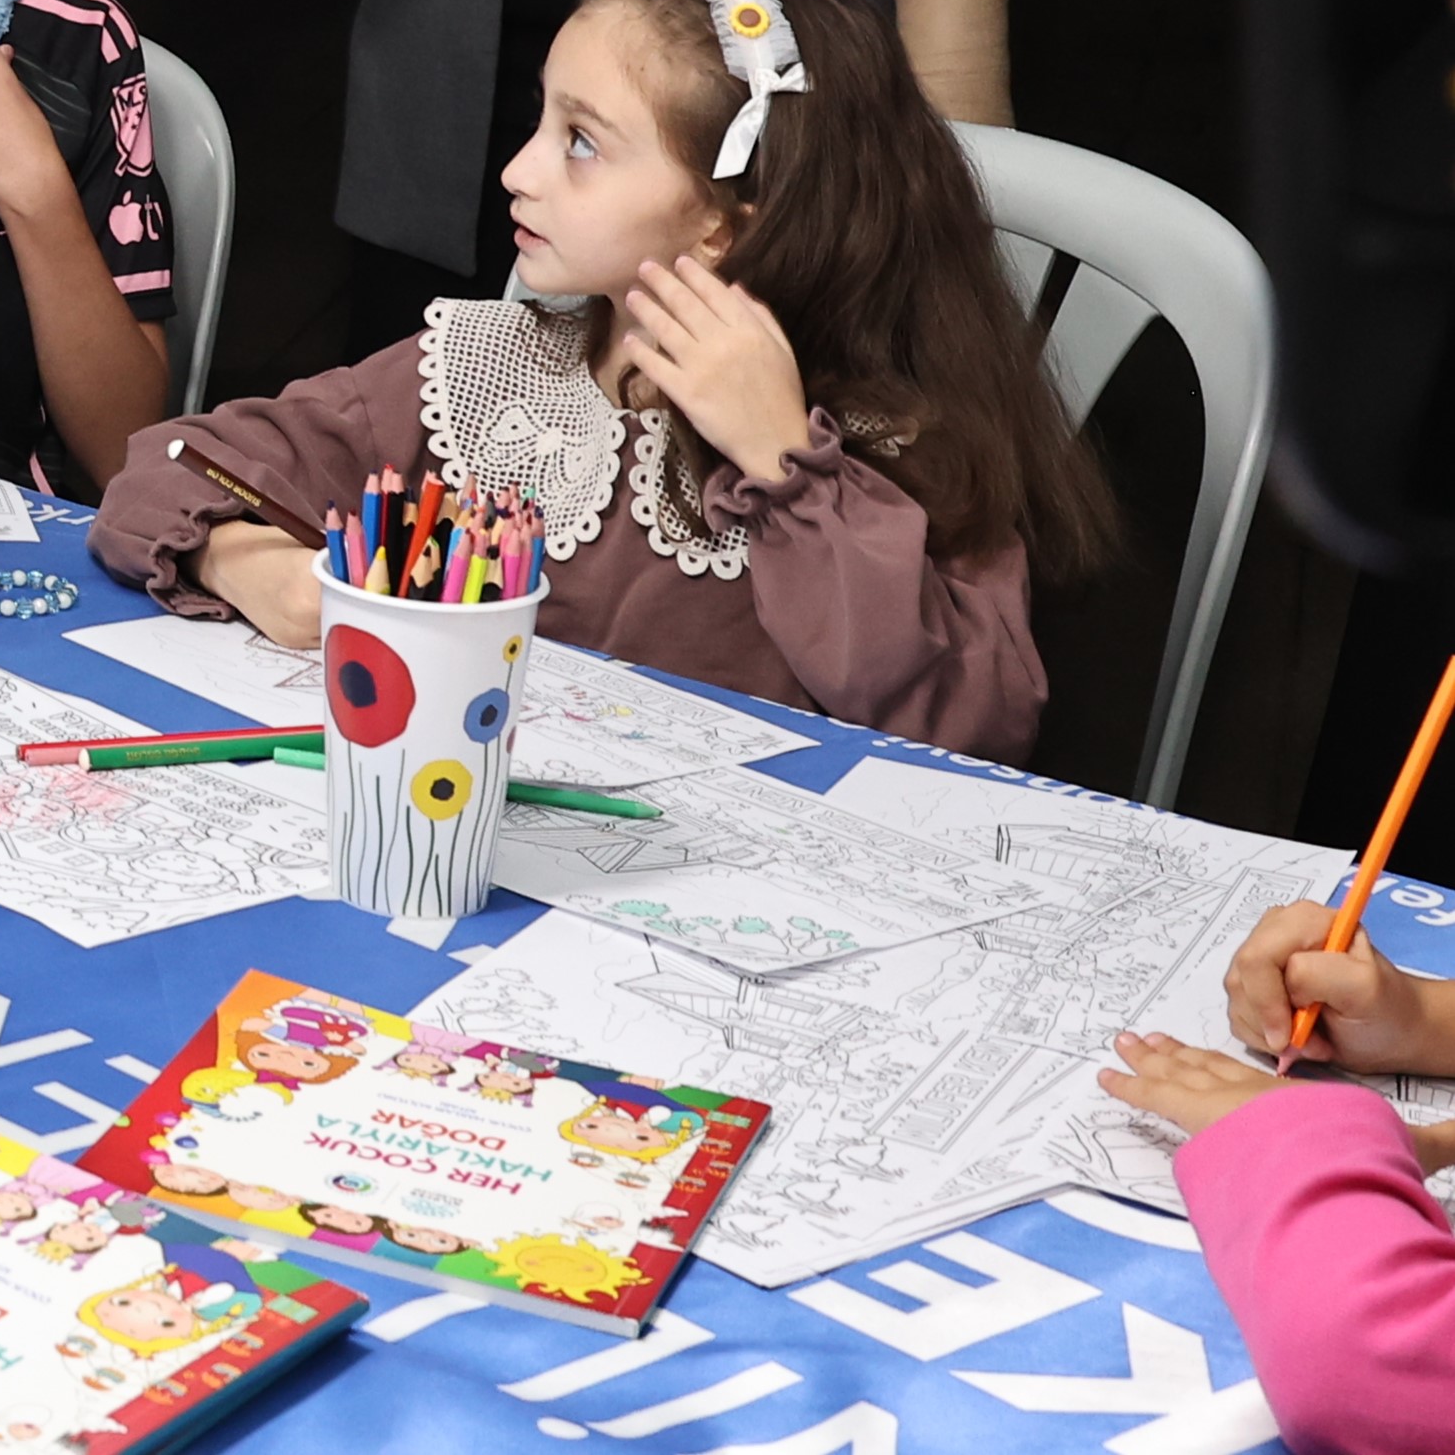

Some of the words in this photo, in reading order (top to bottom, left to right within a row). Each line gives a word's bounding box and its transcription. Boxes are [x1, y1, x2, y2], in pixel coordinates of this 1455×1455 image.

[317, 1114, 552, 1182] HAKLARIYLA
[371, 1109, 506, 1151] DOĞAR
[304, 1132, 438, 1175] ÇOCUK
[447, 1168, 522, 1195] HER
